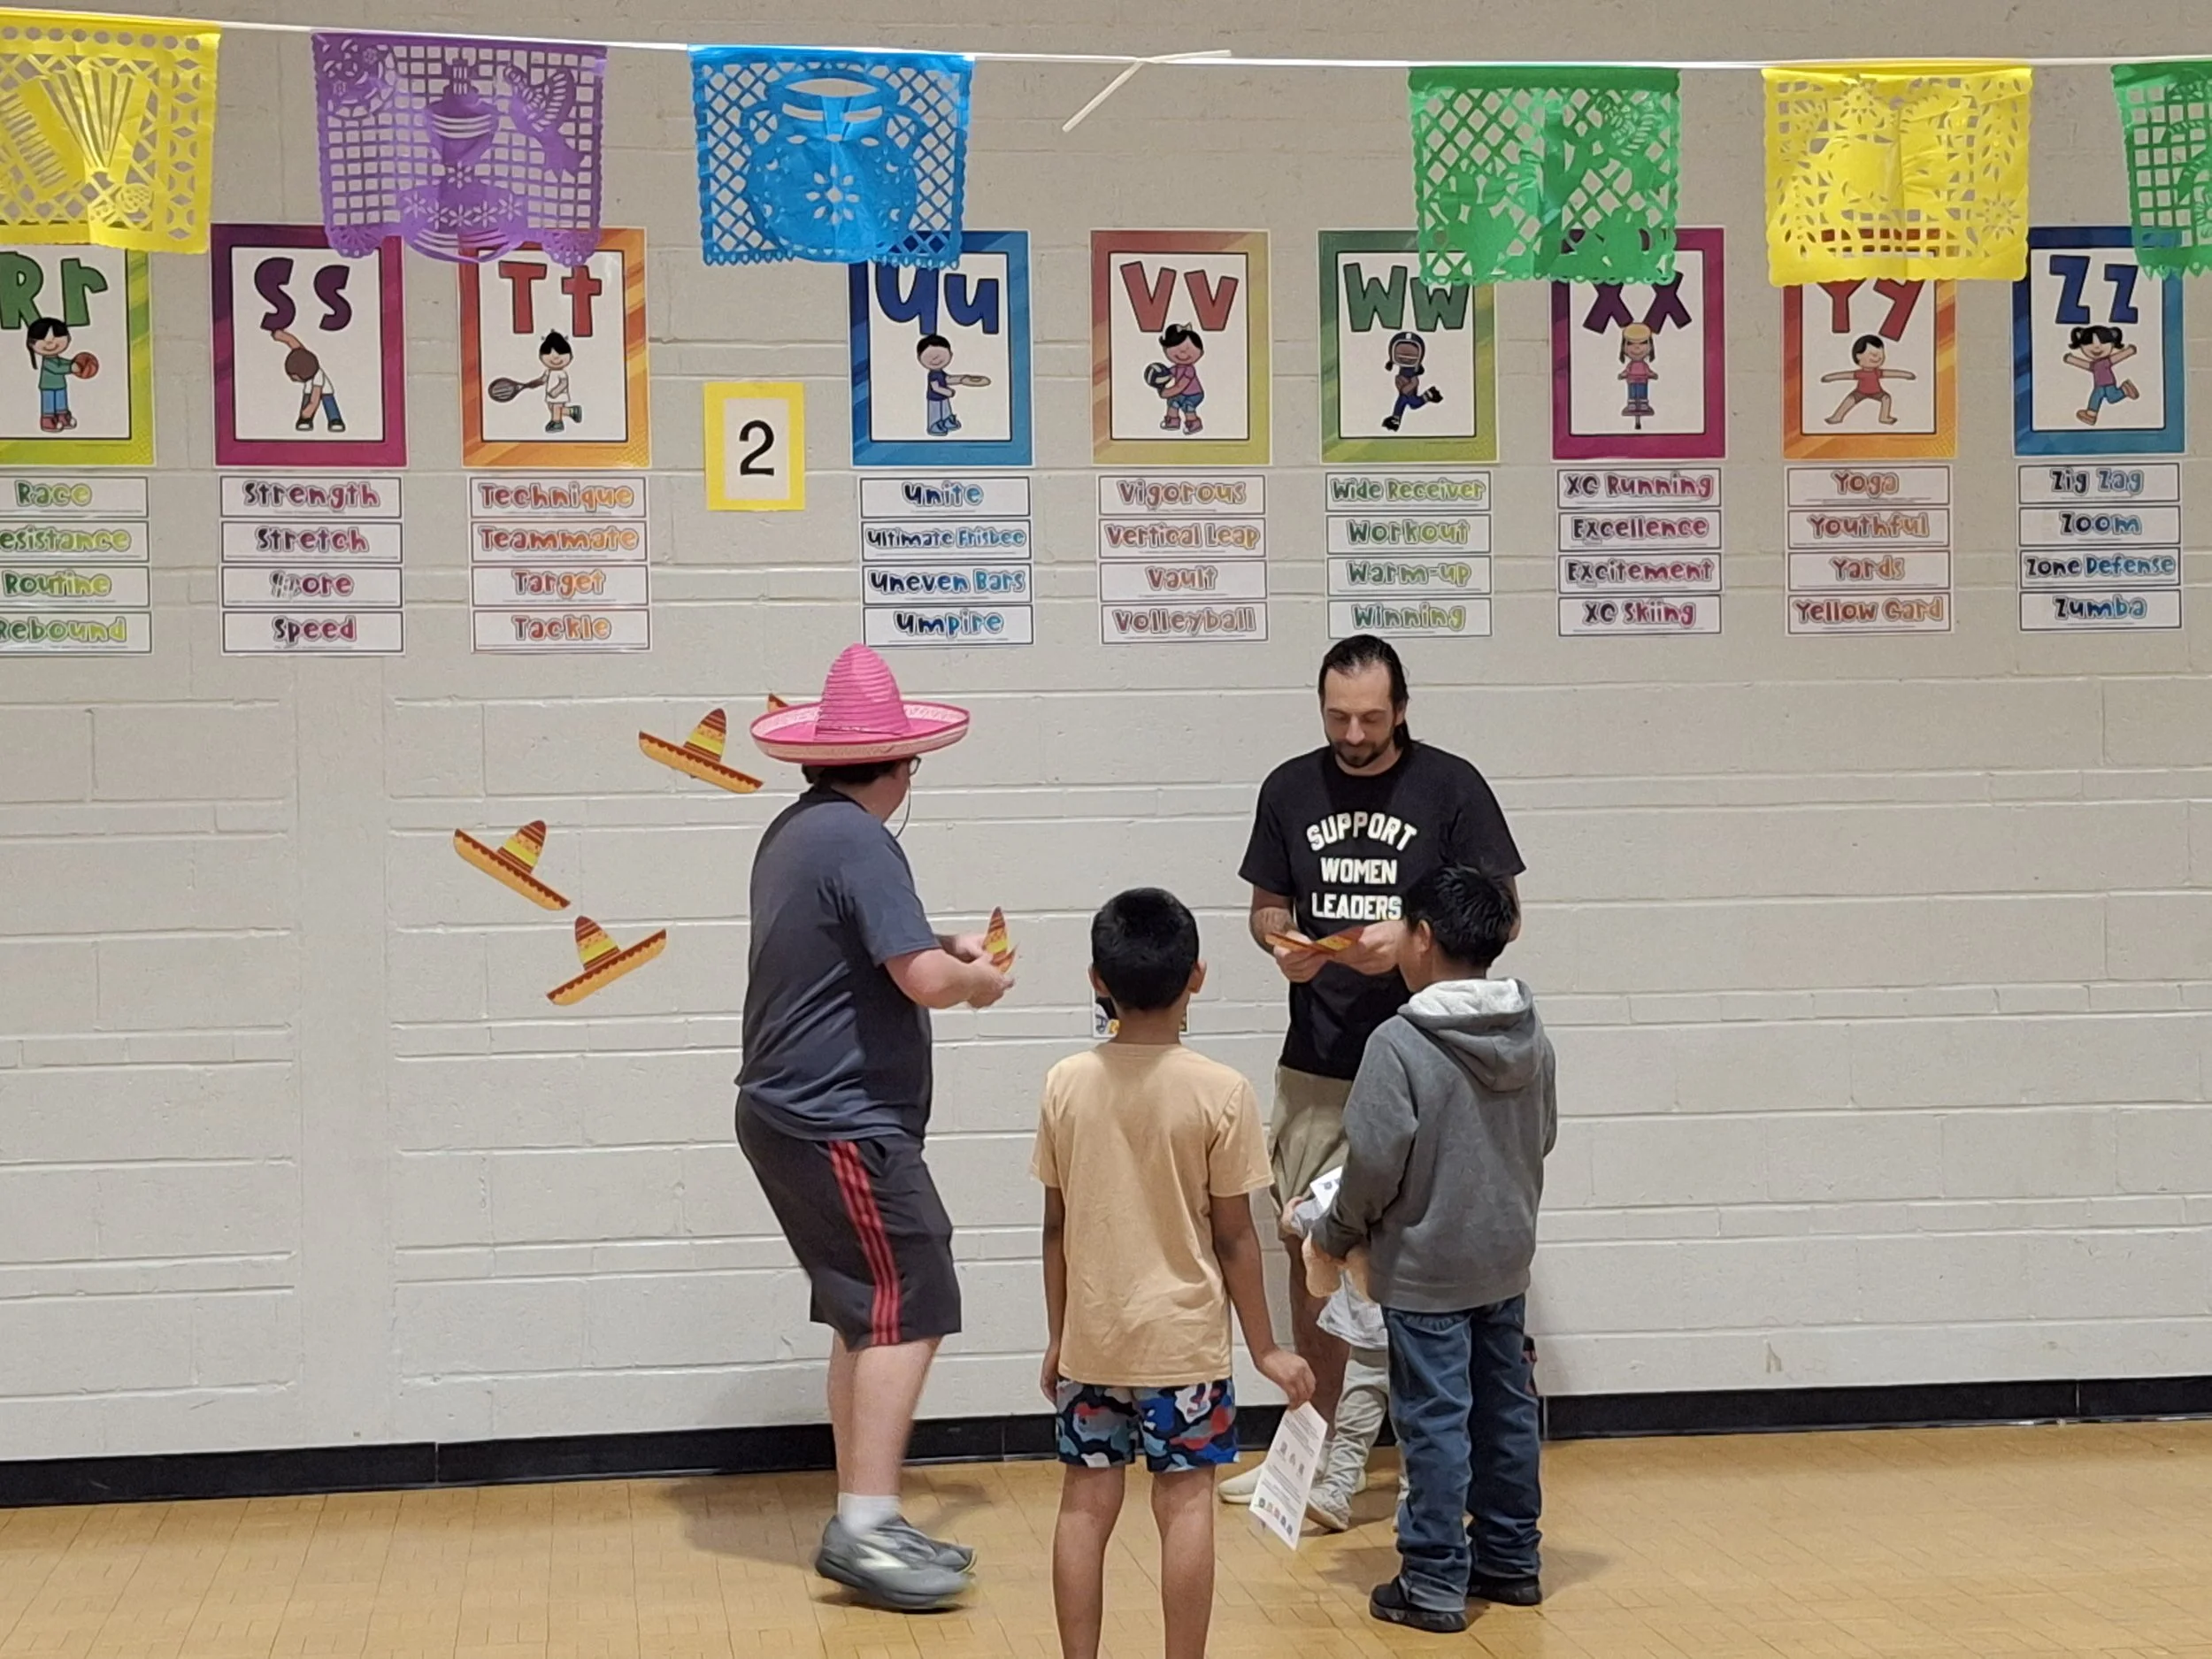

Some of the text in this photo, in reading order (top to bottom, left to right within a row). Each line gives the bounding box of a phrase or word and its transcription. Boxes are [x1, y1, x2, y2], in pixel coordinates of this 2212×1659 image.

[255, 257, 352, 332] Ss
[499, 261, 603, 337] Tt
[1119, 261, 1239, 332] Vv
[1343, 263, 1471, 332] Ww
[2049, 255, 2139, 324] Zz
[739, 419, 775, 476] 2
[16, 480, 91, 505] Race
[902, 480, 983, 506] Unite
[1118, 480, 1246, 509] Vigorous
[1332, 477, 1485, 501] Wide Receiver
[1565, 471, 1713, 499] XC Running
[1832, 470, 1899, 497] Yoga
[2051, 467, 2144, 495] Zig Zag
[243, 481, 380, 511] Strength
[479, 482, 634, 511] Technique
[1105, 523, 1260, 549] Vertical Leap
[1347, 519, 1471, 544] Workout
[1572, 516, 1709, 542] Excellence
[1808, 512, 1930, 538] Youthful
[2060, 511, 2141, 534] Zoom
[0, 525, 131, 551] esistance
[256, 526, 369, 552] Stretch
[479, 526, 638, 550] Teammate
[867, 526, 1026, 549] Ultimate Frisbee
[1146, 565, 1217, 590] Vault
[1347, 560, 1471, 587] Warm-up
[1566, 558, 1713, 586] Excitement
[1830, 556, 1904, 580] Yards
[2025, 554, 2176, 577] Zone Defense
[3, 570, 111, 596] Routine
[512, 569, 605, 598] Target
[868, 568, 1025, 595] Uneven Bars
[1352, 603, 1465, 631] Winning
[1583, 598, 1695, 628] XC Skiing
[1793, 596, 1943, 623] Yellow Card
[2054, 594, 2147, 620] Zumba
[0, 617, 127, 641] Rebound
[273, 616, 356, 645] Speed
[512, 615, 611, 640] Tackle
[895, 609, 1003, 637] Umpire
[1113, 608, 1256, 636] Volleyball
[1306, 810, 1417, 851] SUPPORT
[1320, 856, 1397, 885] WOMEN
[1311, 892, 1402, 920] LEADERS
